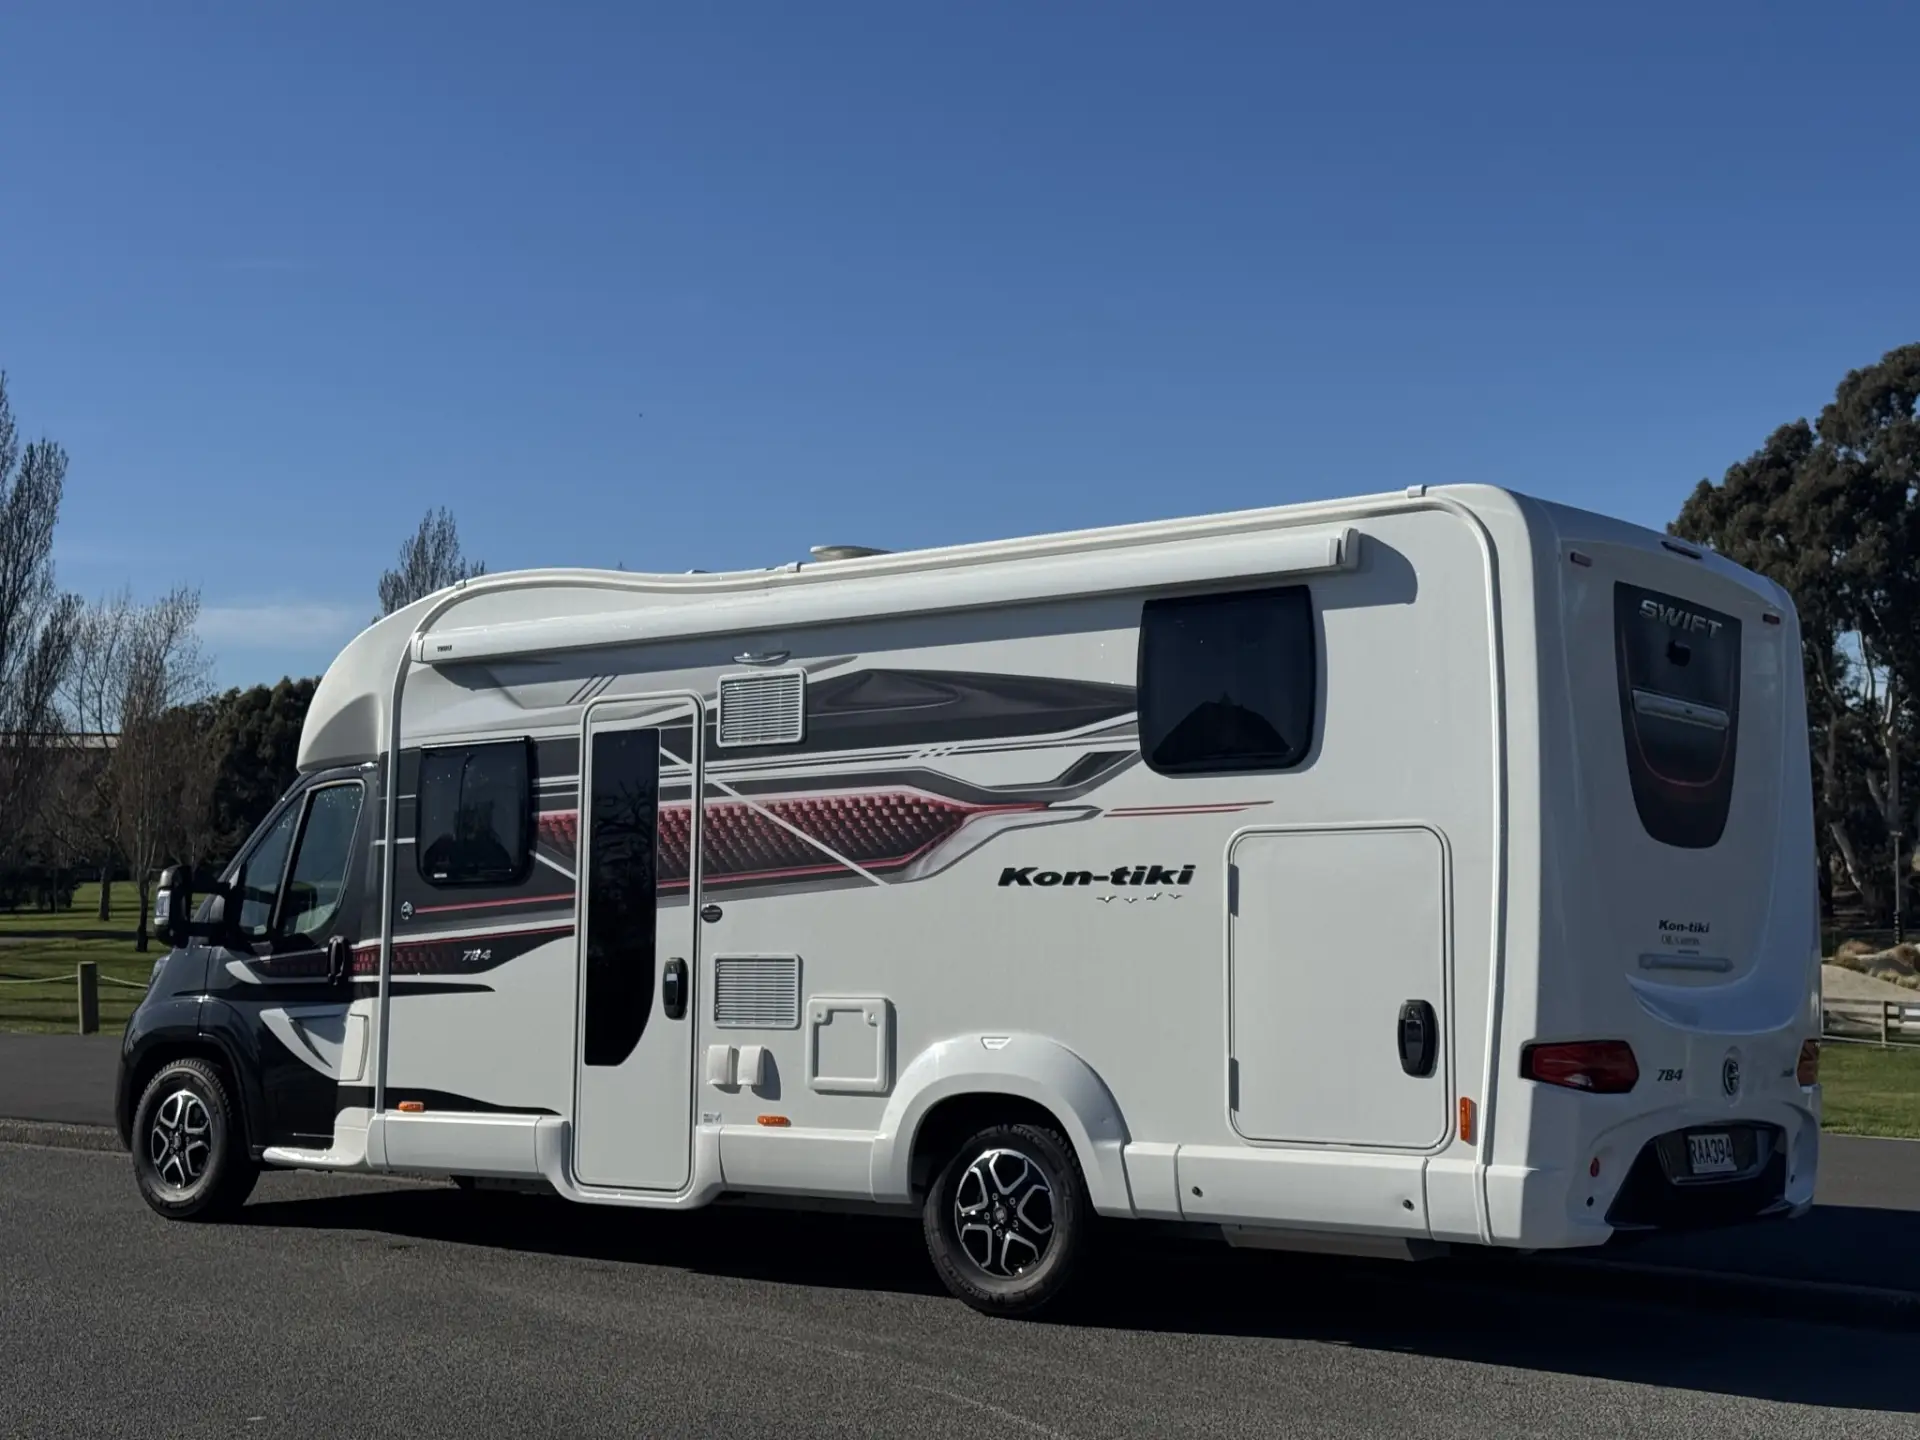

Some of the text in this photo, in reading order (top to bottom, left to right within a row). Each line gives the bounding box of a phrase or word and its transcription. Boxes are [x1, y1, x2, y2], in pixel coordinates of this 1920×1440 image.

[1639, 600, 1723, 638] SWIFT
[998, 864, 1196, 886] Kon-tiki
[1658, 920, 1710, 933] Kon-tiki
[1657, 1069, 1683, 1081] 784
